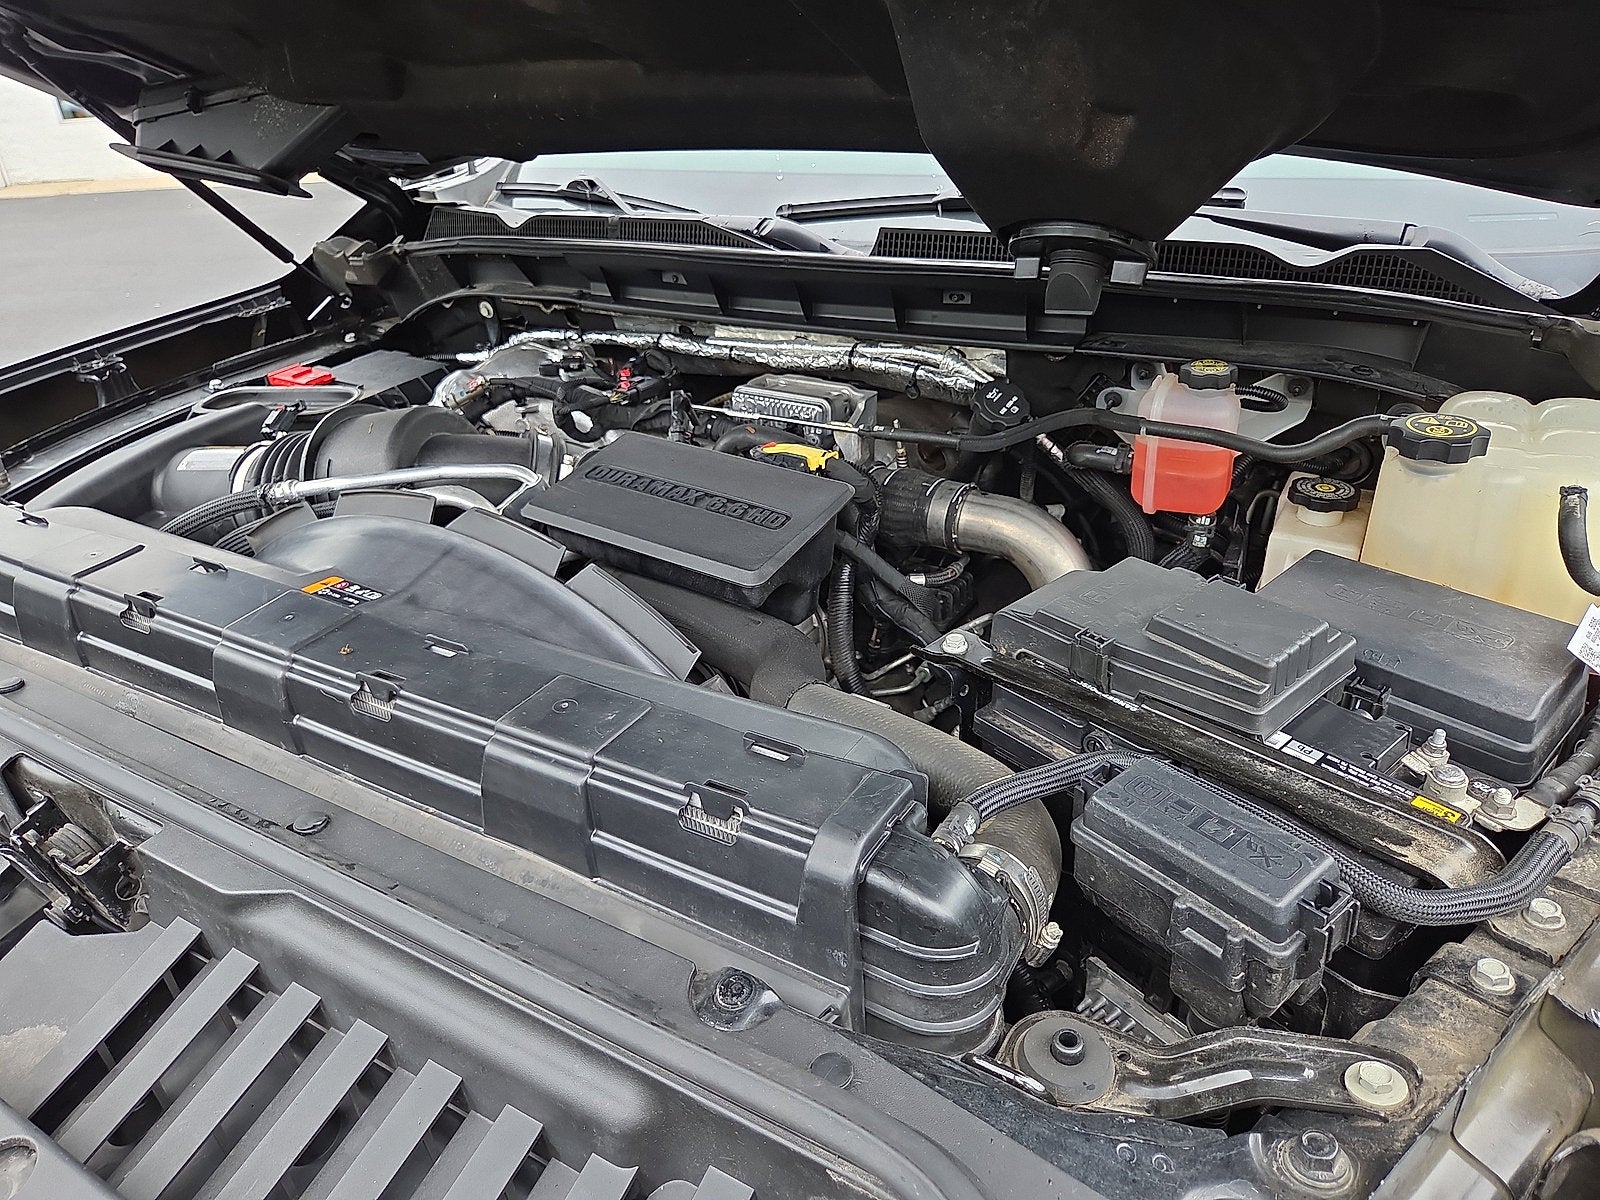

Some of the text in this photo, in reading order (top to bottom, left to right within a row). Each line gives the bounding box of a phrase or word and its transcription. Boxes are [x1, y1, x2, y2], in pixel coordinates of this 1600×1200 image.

[590, 465, 788, 528] DURAMAX 6.6 HD
